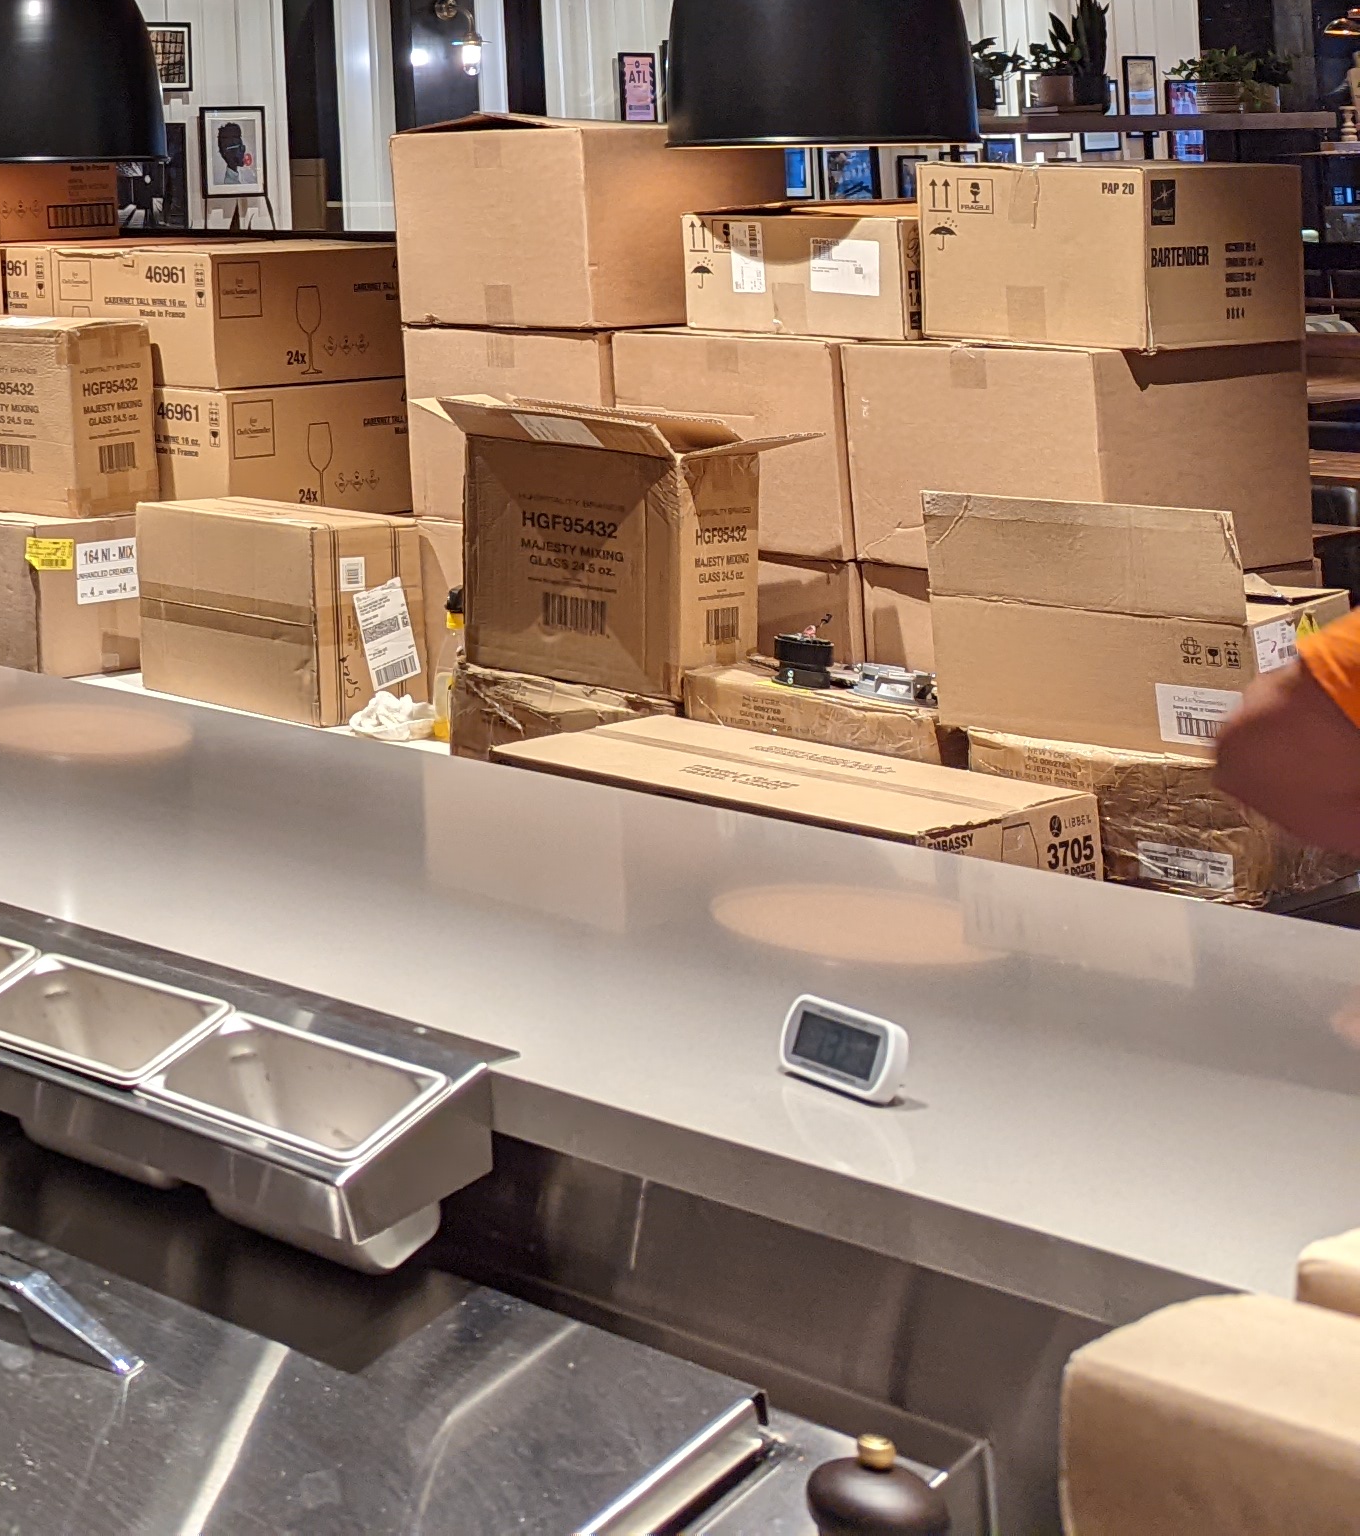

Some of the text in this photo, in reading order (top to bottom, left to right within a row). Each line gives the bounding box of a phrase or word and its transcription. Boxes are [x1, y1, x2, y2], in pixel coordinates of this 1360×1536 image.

[629, 70, 647, 84] ATL
[1102, 182, 1135, 195] PAP 20
[1151, 246, 1209, 268] BARTENDER
[145, 265, 186, 285] 46961
[104, 296, 134, 306] CABERNET
[136, 297, 150, 306] TALL
[152, 298, 167, 307] WINE
[139, 309, 156, 317] Made
[165, 309, 185, 318] France
[287, 350, 307, 366] 24x
[82, 378, 138, 397] HGF95432
[11, 403, 39, 414] MIXING
[83, 400, 143, 414] MAJESTY MIXING
[157, 402, 199, 422] 46961
[7, 416, 22, 424] 24.5
[89, 416, 111, 426] GLASS
[113, 414, 127, 423] 24.5
[177, 448, 199, 457] France
[299, 488, 318, 503] 24x
[521, 511, 618, 539] HGF95432
[695, 525, 747, 545] HGF95432
[84, 549, 98, 564] 164
[101, 548, 110, 561] NI
[118, 545, 134, 559] MIX
[520, 538, 624, 563] MAJESTY MIXING
[530, 554, 616, 577] GLASS 24.5 oz.
[695, 553, 749, 568] MAJESTY MIXING
[109, 567, 134, 577] CREAMER
[698, 571, 720, 584] GLASS
[721, 571, 735, 581] 24.5
[90, 587, 95, 596] 4
[118, 583, 127, 593] 14
[1183, 655, 1202, 665] arc
[1047, 835, 1094, 870] 3705
[1070, 861, 1096, 875] DOZEN
